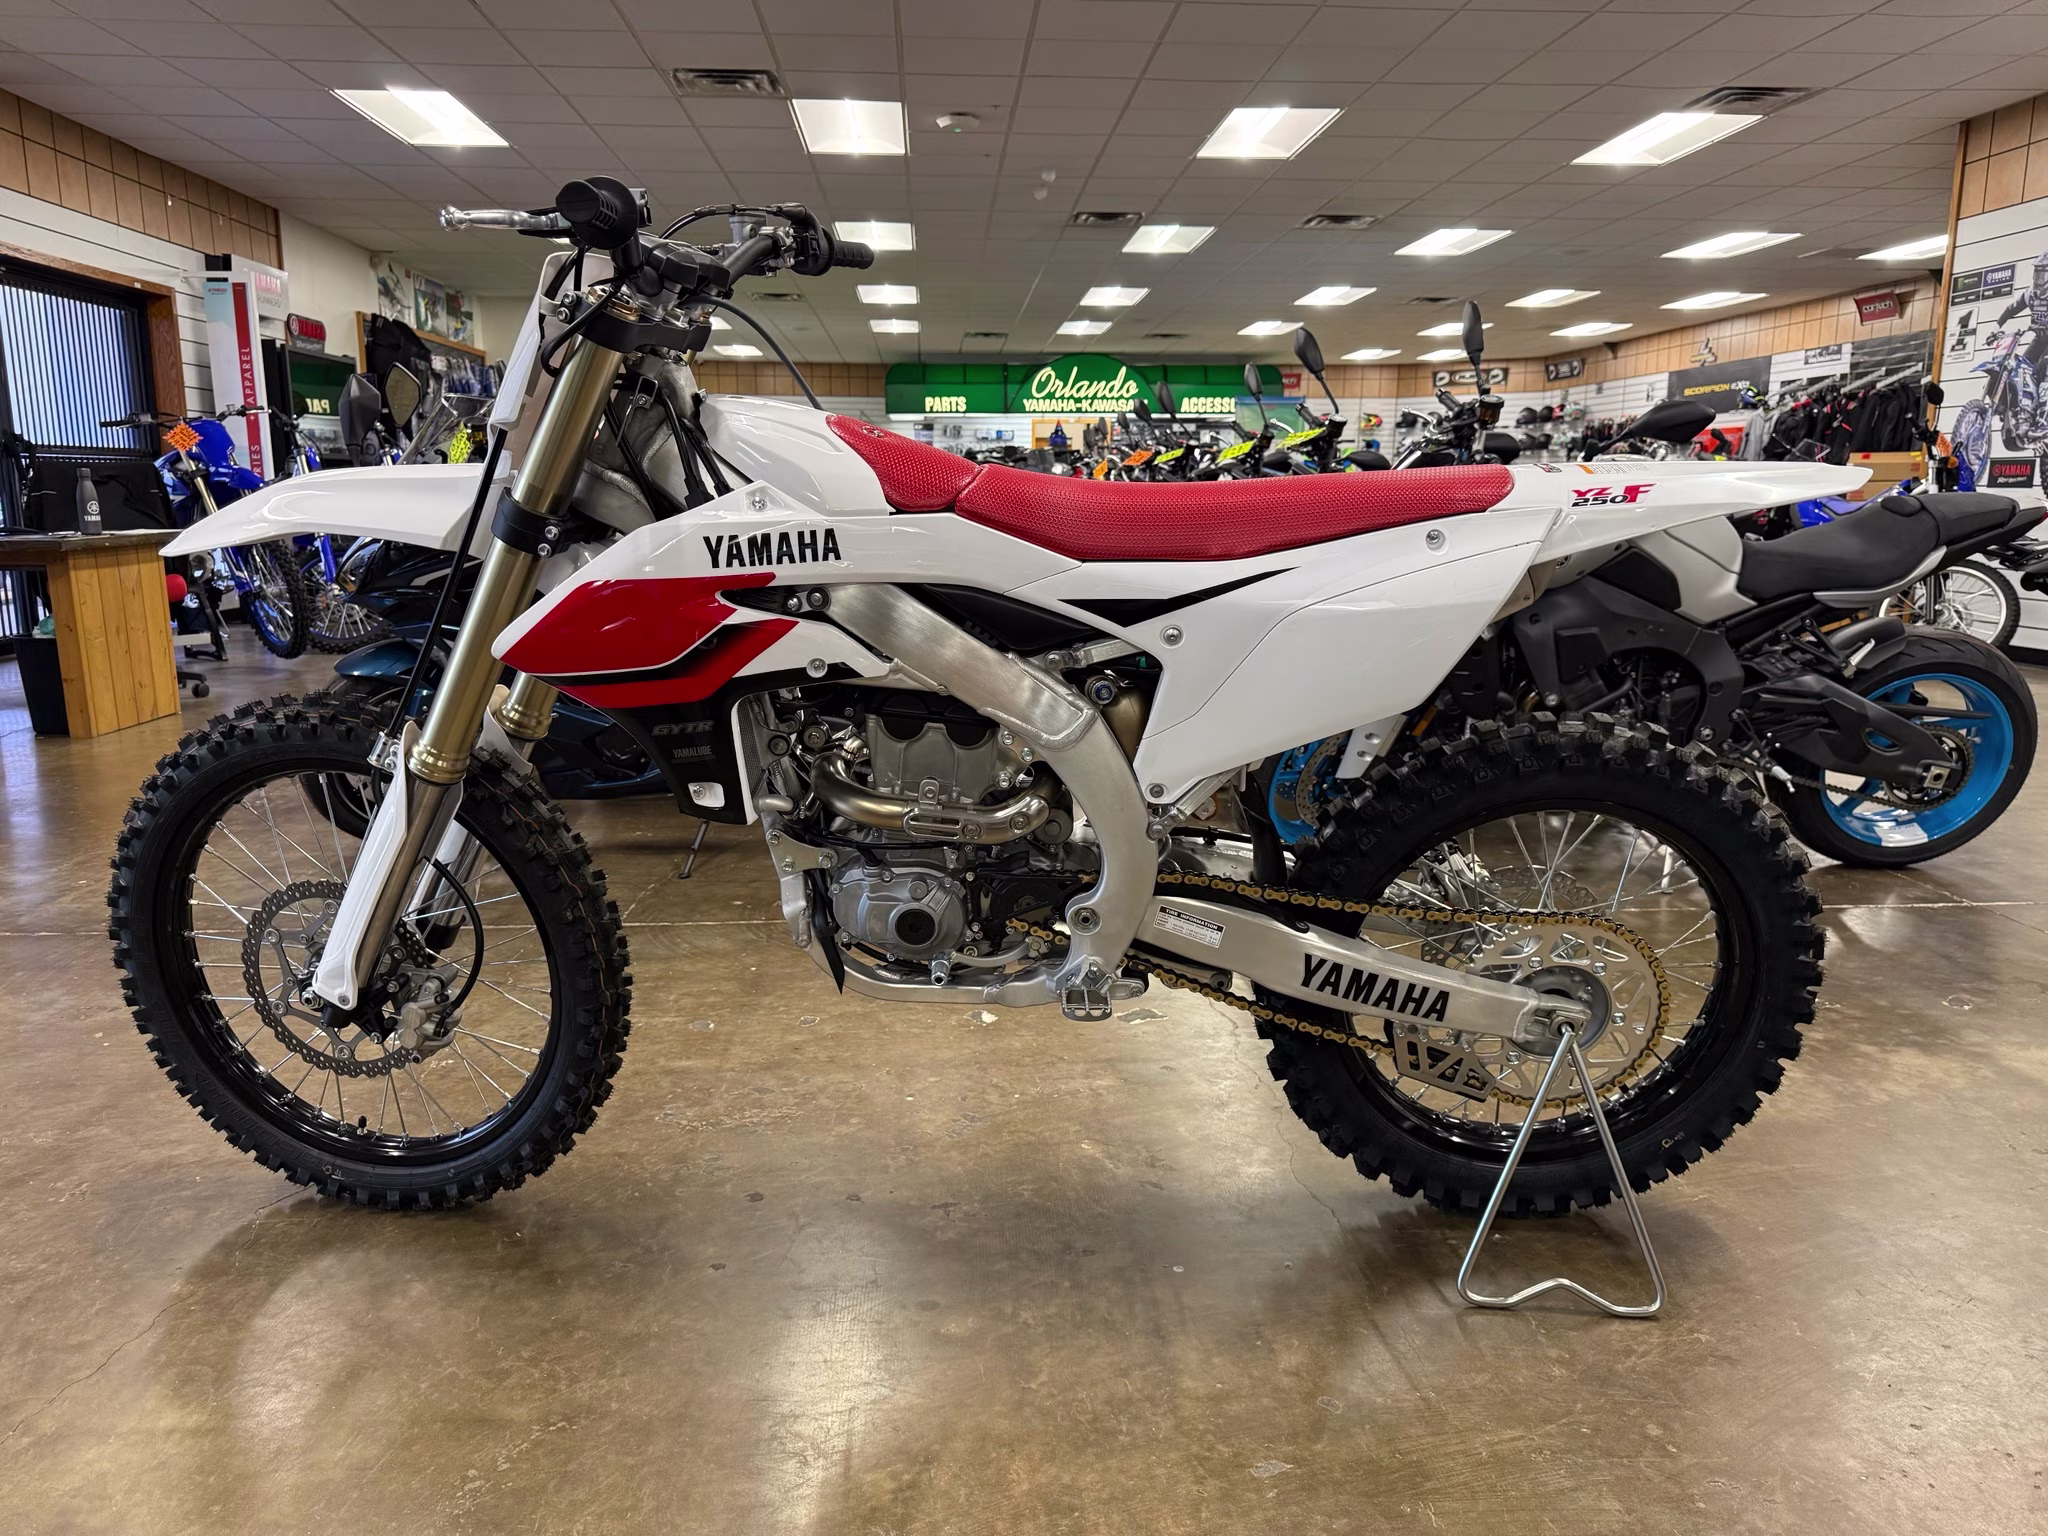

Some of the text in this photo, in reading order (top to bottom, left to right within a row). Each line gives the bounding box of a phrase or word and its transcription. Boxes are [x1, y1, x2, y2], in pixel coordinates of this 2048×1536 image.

[241, 347, 256, 404] APPAREL
[1031, 365, 1139, 398] Orlando
[1683, 383, 1730, 397] SCORPION
[924, 396, 967, 412] PARTS
[1022, 399, 1136, 412] YAMAHA-KAWASA
[2001, 464, 2031, 476] YAMAHA
[702, 528, 842, 569] YAMAHA
[651, 720, 715, 736] GYTR
[672, 745, 713, 758] YAMALUBE
[1165, 908, 1179, 917] TIRE
[1180, 912, 1218, 930] INFORMATION
[1300, 953, 1450, 1023] YAMAHA
